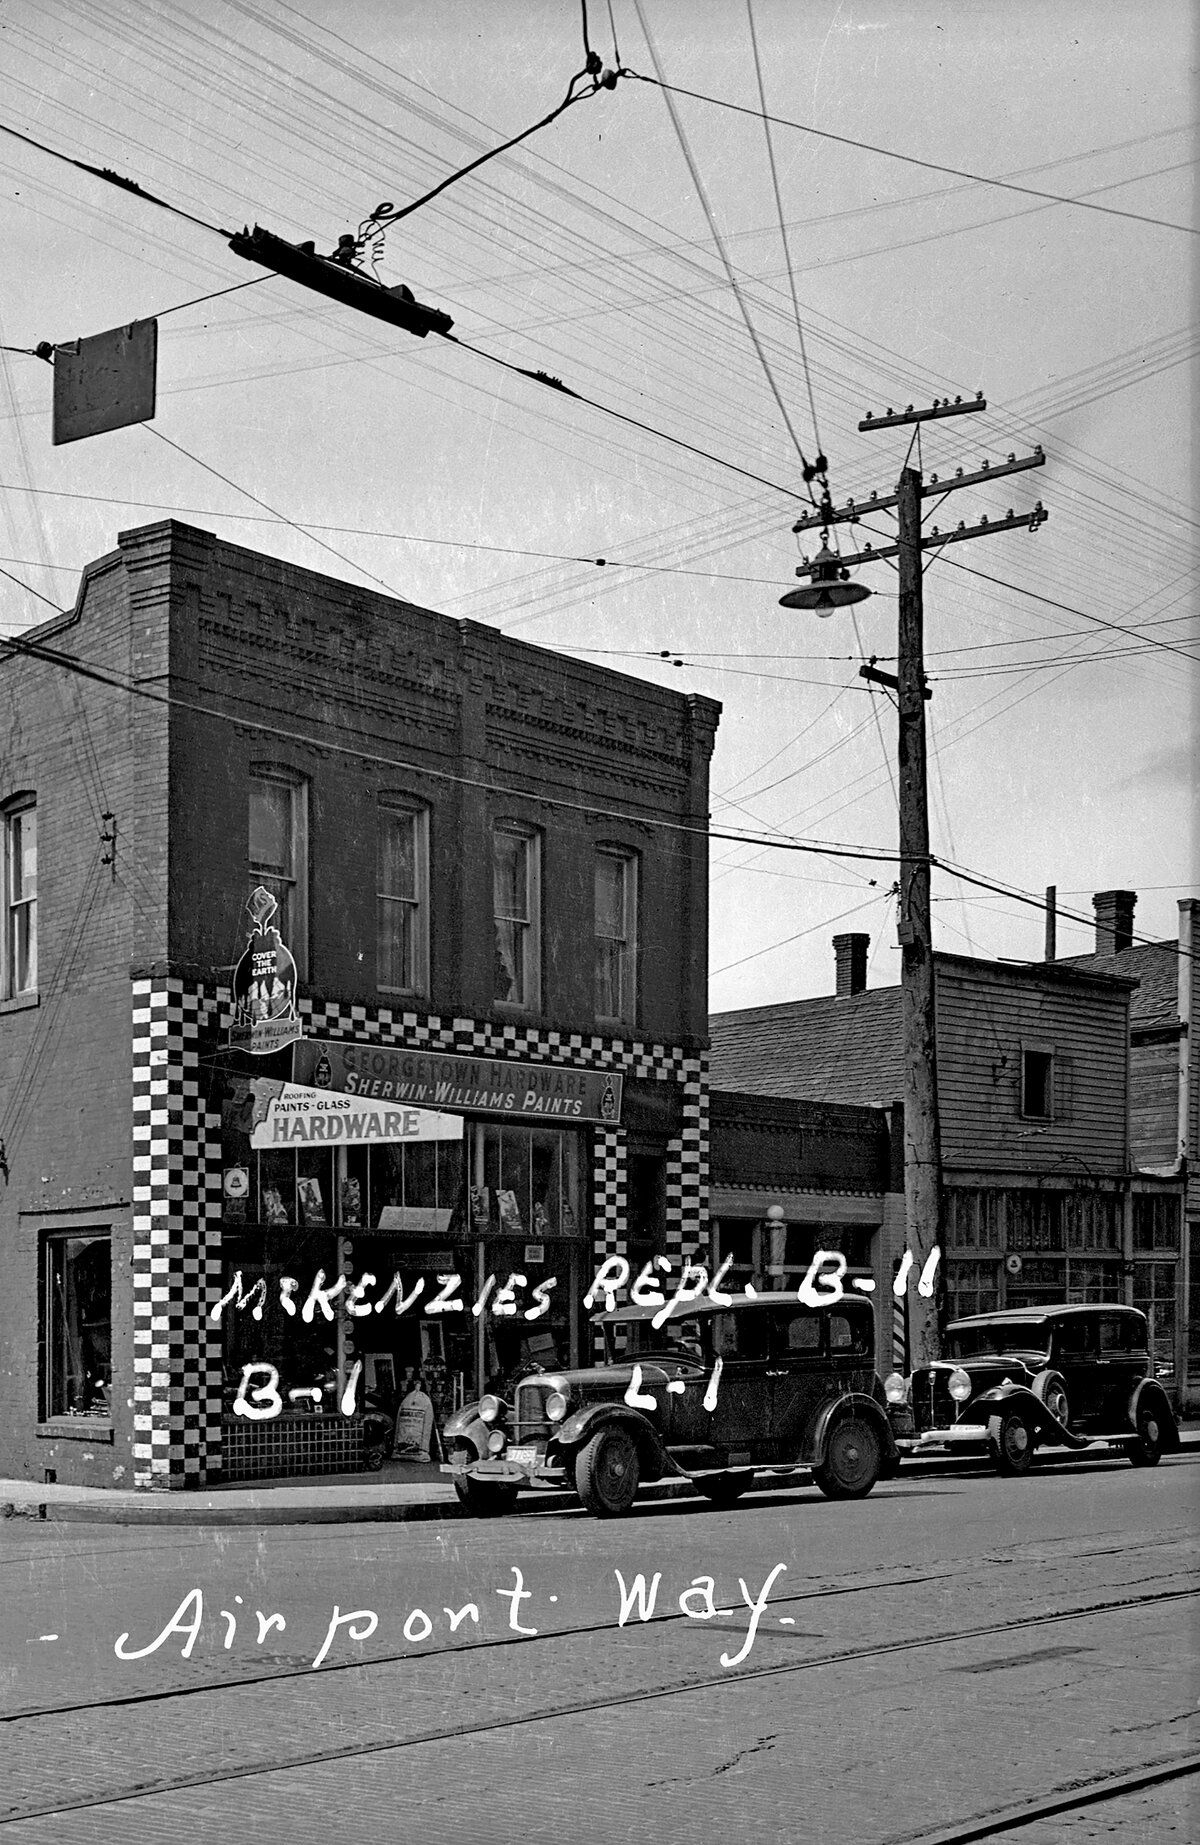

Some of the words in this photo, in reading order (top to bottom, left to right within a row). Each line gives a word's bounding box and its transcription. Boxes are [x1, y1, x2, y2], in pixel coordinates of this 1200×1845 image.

[252, 951, 277, 961] COVER
[256, 959, 272, 967] THE
[252, 966, 277, 976] EARTH
[343, 1046, 480, 1080] GEORGETOWN
[490, 1063, 587, 1096] HARDWARE
[284, 1092, 316, 1100] ROOFING
[274, 1101, 309, 1112] PAINTS
[317, 1100, 350, 1110] GLASS
[522, 1091, 583, 1115] PAINTS
[273, 1110, 420, 1142] HARDWARE
